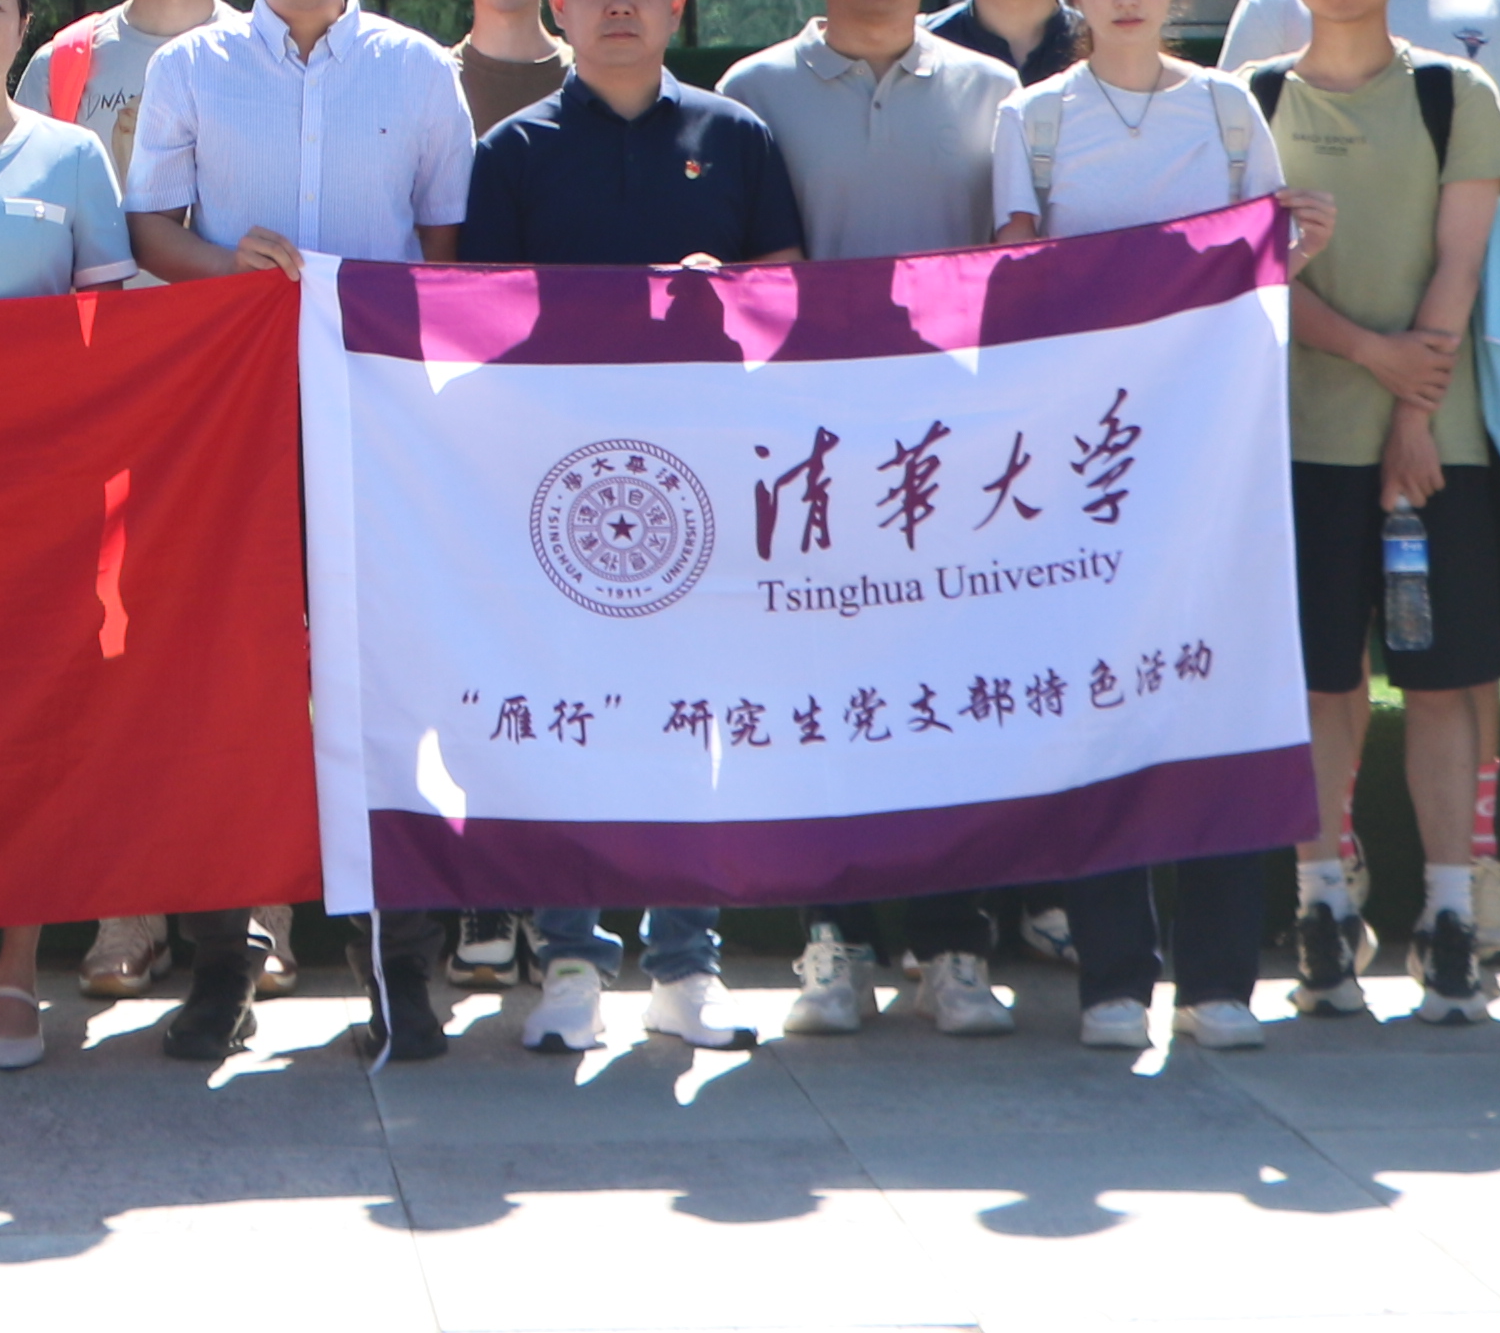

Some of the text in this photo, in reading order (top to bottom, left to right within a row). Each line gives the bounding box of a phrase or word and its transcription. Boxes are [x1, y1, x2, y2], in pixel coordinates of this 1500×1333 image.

[547, 504, 584, 584] TSINGHUA
[660, 507, 698, 585] UNIVERSITY
[757, 545, 1124, 618] Tsinghua University
